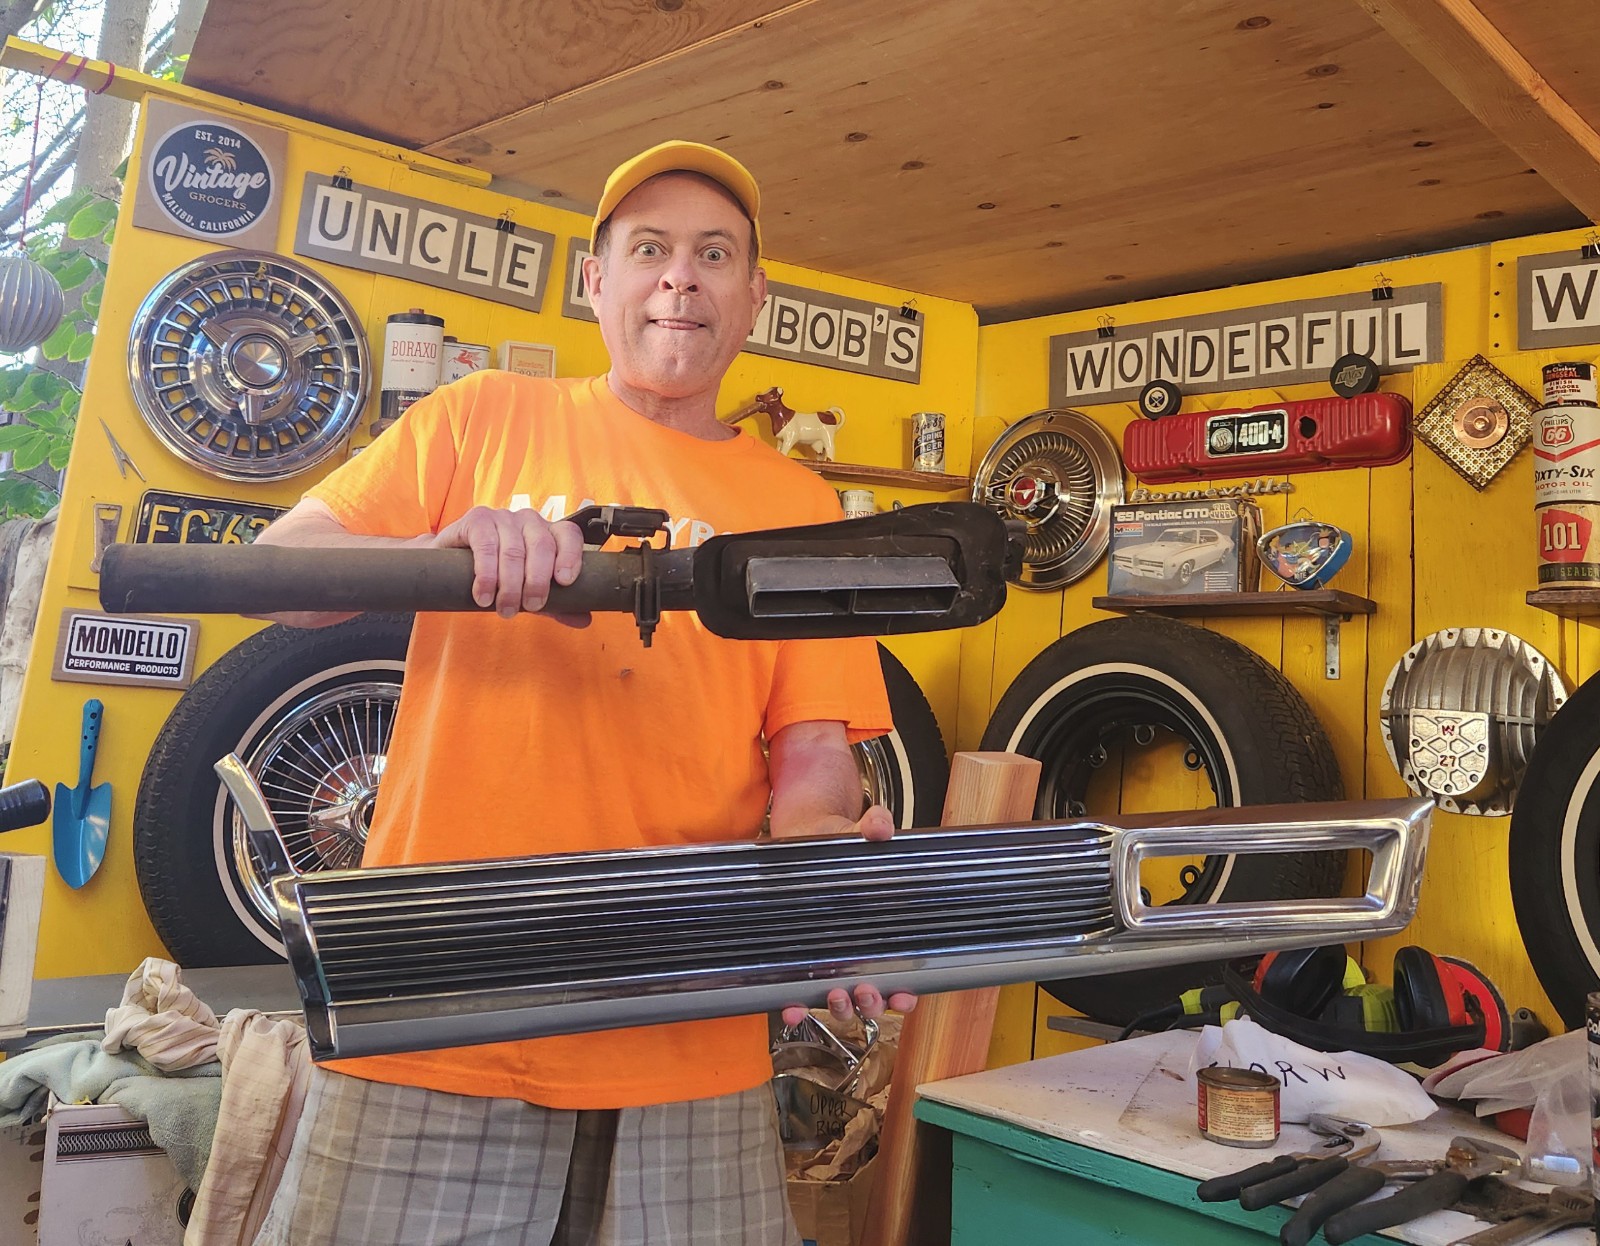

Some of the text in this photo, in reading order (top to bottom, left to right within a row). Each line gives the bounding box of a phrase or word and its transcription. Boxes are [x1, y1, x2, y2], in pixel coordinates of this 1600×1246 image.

[195, 129, 241, 149] EST. 2014
[155, 152, 267, 200] Vintage
[189, 191, 248, 211] GROCERS
[199, 210, 256, 232] CALIFORNIA
[318, 195, 535, 288] UNCLE
[1535, 269, 1599, 323] W
[391, 340, 438, 359] BORAXO
[1069, 312, 1421, 391] WONDERFUL
[1544, 418, 1569, 427] PHILLIPS
[1545, 427, 1567, 442] 66
[1534, 464, 1596, 484] SIXTY-SIX
[1130, 477, 1296, 503] Bonneville
[1535, 480, 1593, 491] MOTOR OIL
[1135, 509, 1182, 521] Pontiac
[1182, 507, 1210, 519] GTO
[1543, 521, 1582, 551] 101
[75, 625, 180, 659] MONDELLO
[67, 658, 179, 675] PERFORMANCE PRODUCTS
[1439, 754, 1458, 768] 27
